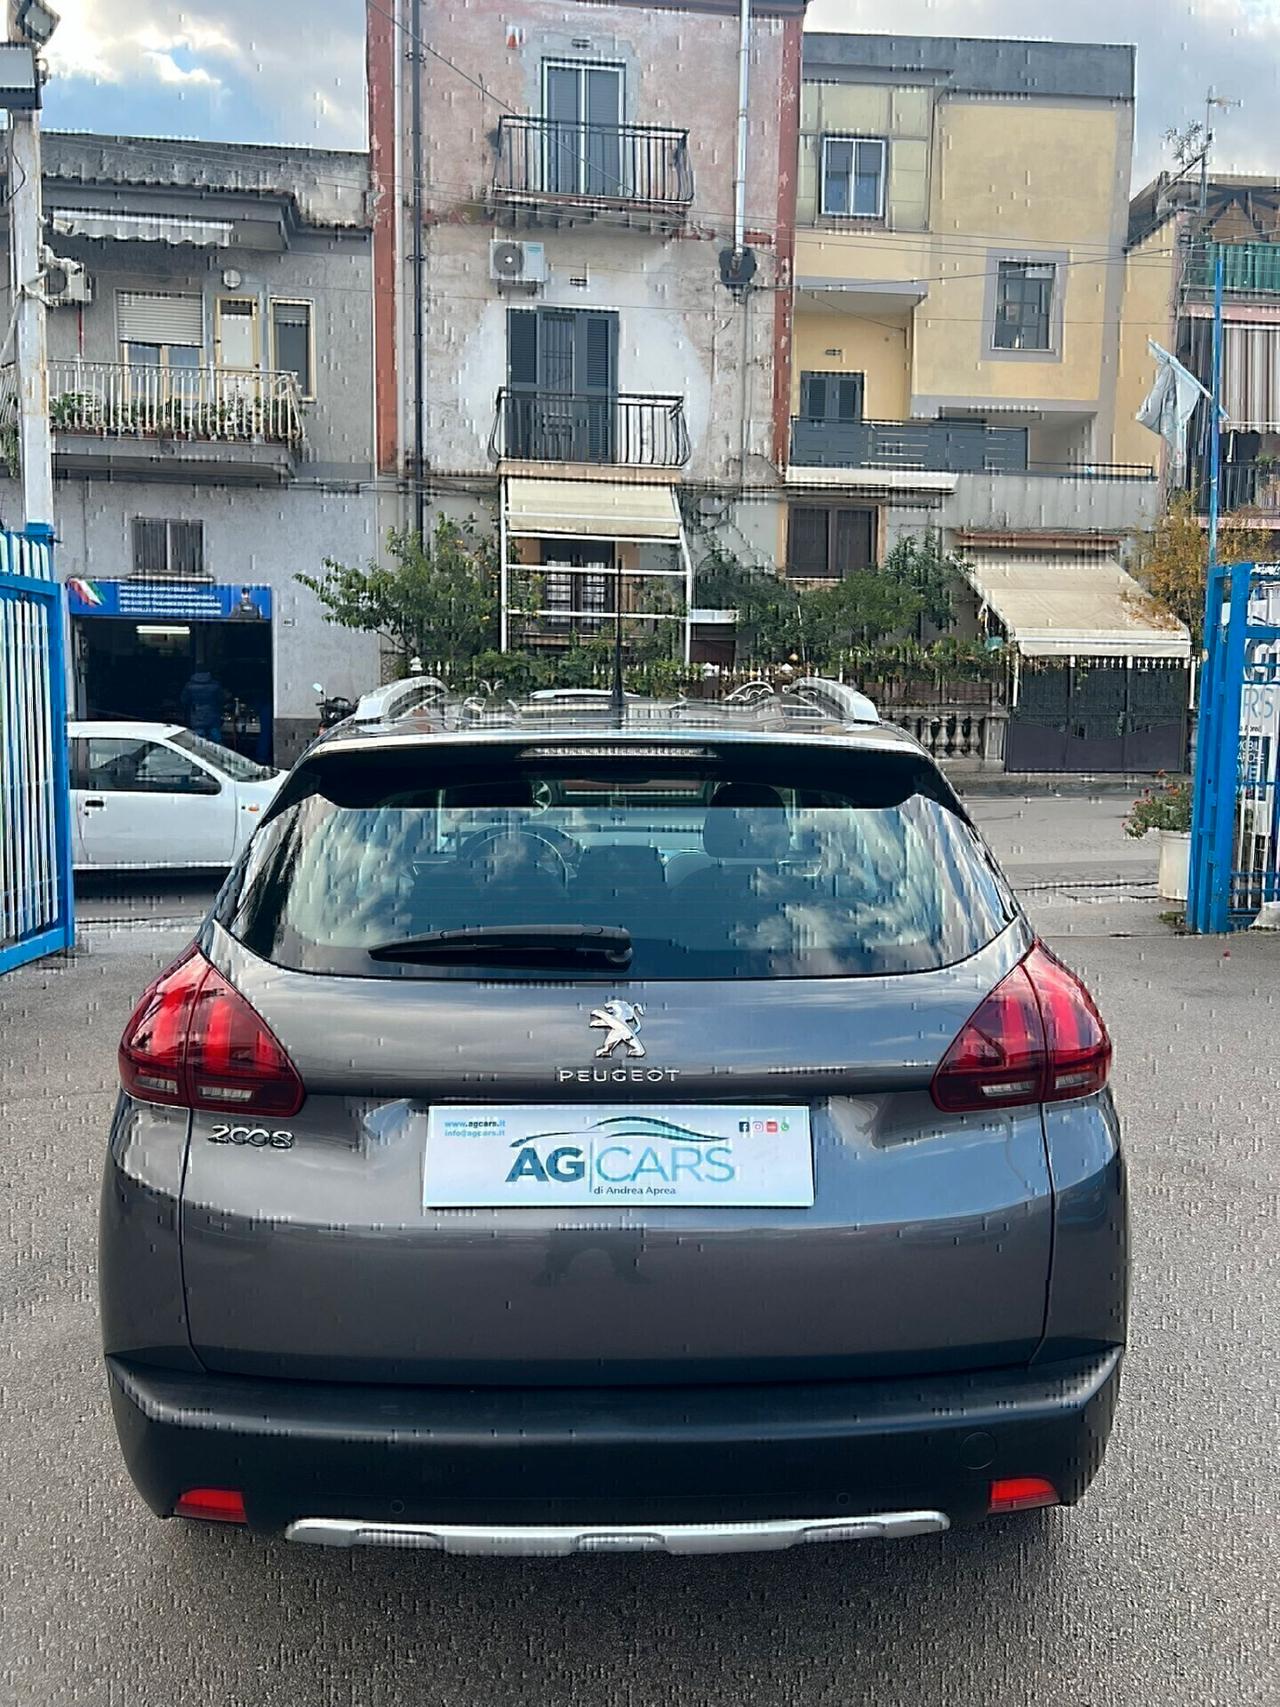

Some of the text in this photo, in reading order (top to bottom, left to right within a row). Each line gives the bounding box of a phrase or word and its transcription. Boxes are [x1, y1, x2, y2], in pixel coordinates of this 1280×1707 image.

[559, 1070, 680, 1082] PEUGEOT
[444, 1119, 506, 1128] www.agcars.it
[208, 1124, 294, 1149] 2008
[444, 1129, 505, 1138] info@agcars.it
[505, 1146, 735, 1183] AG CARS
[593, 1186, 676, 1197] di Andrea Aprea
